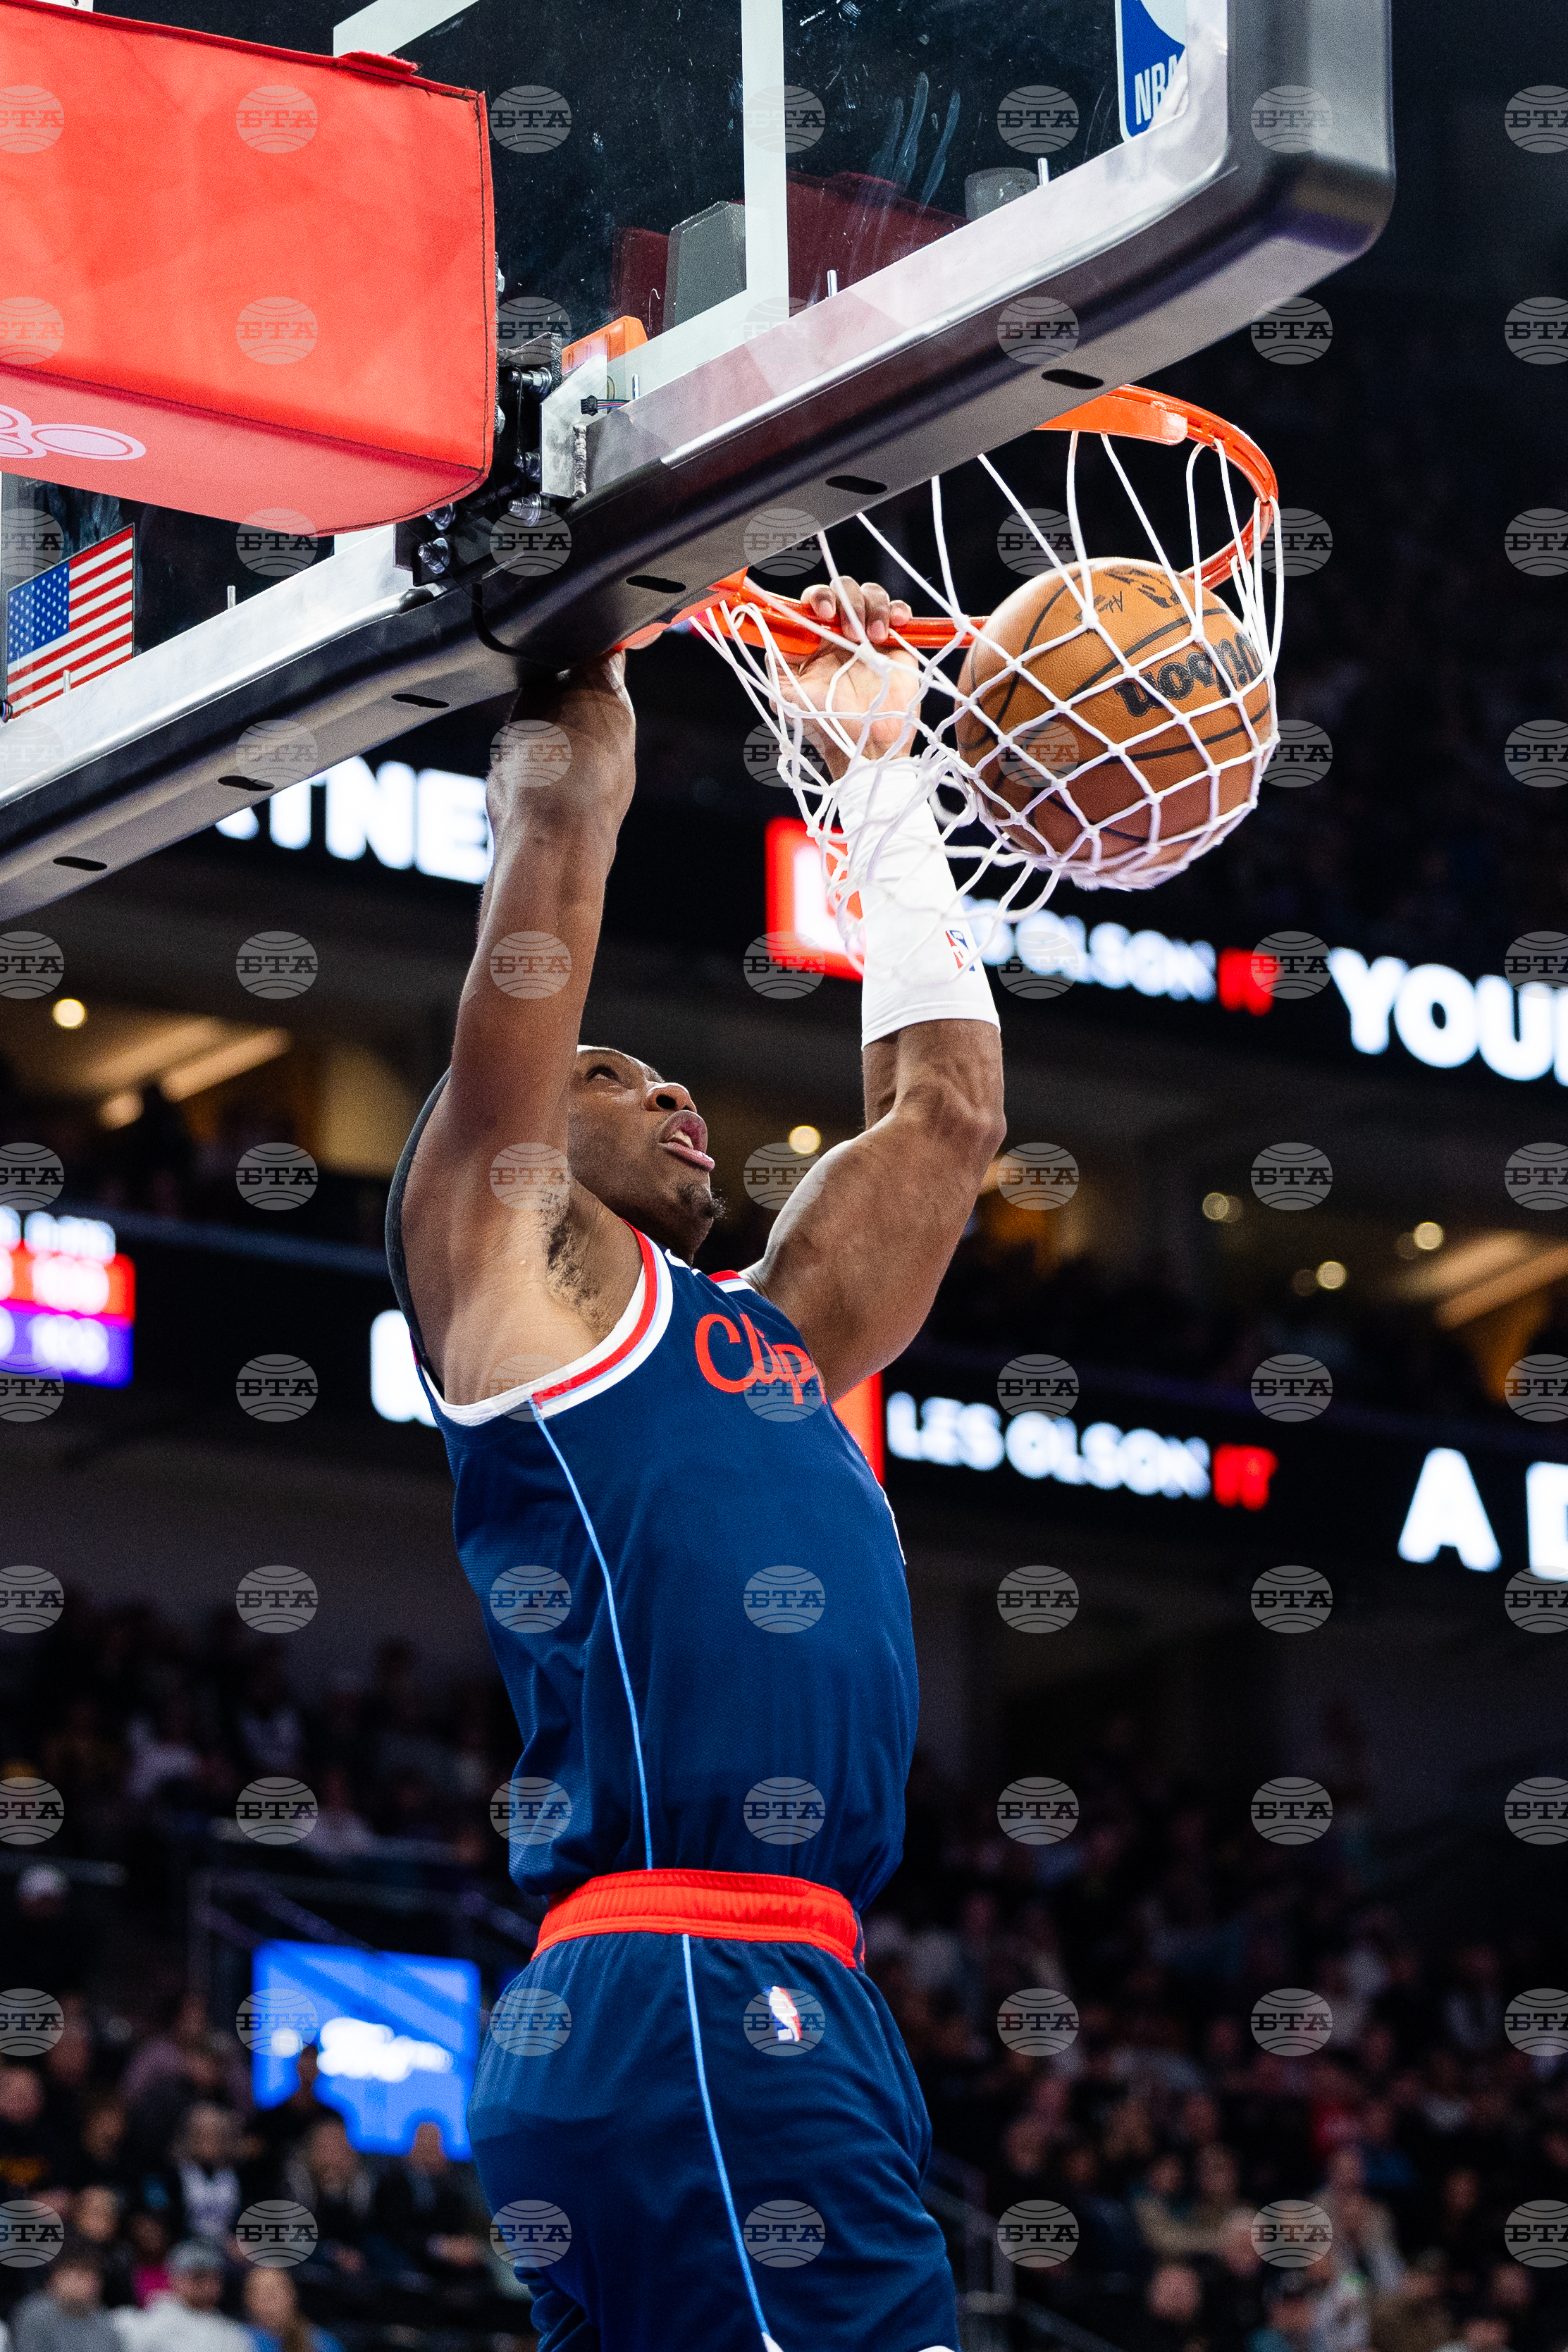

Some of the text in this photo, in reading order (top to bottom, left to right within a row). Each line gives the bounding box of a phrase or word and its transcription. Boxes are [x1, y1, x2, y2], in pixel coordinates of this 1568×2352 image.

[1327, 947, 1568, 1087] YOU
[887, 1391, 1004, 1472] LES
[1005, 1410, 1211, 1499] OLSON
